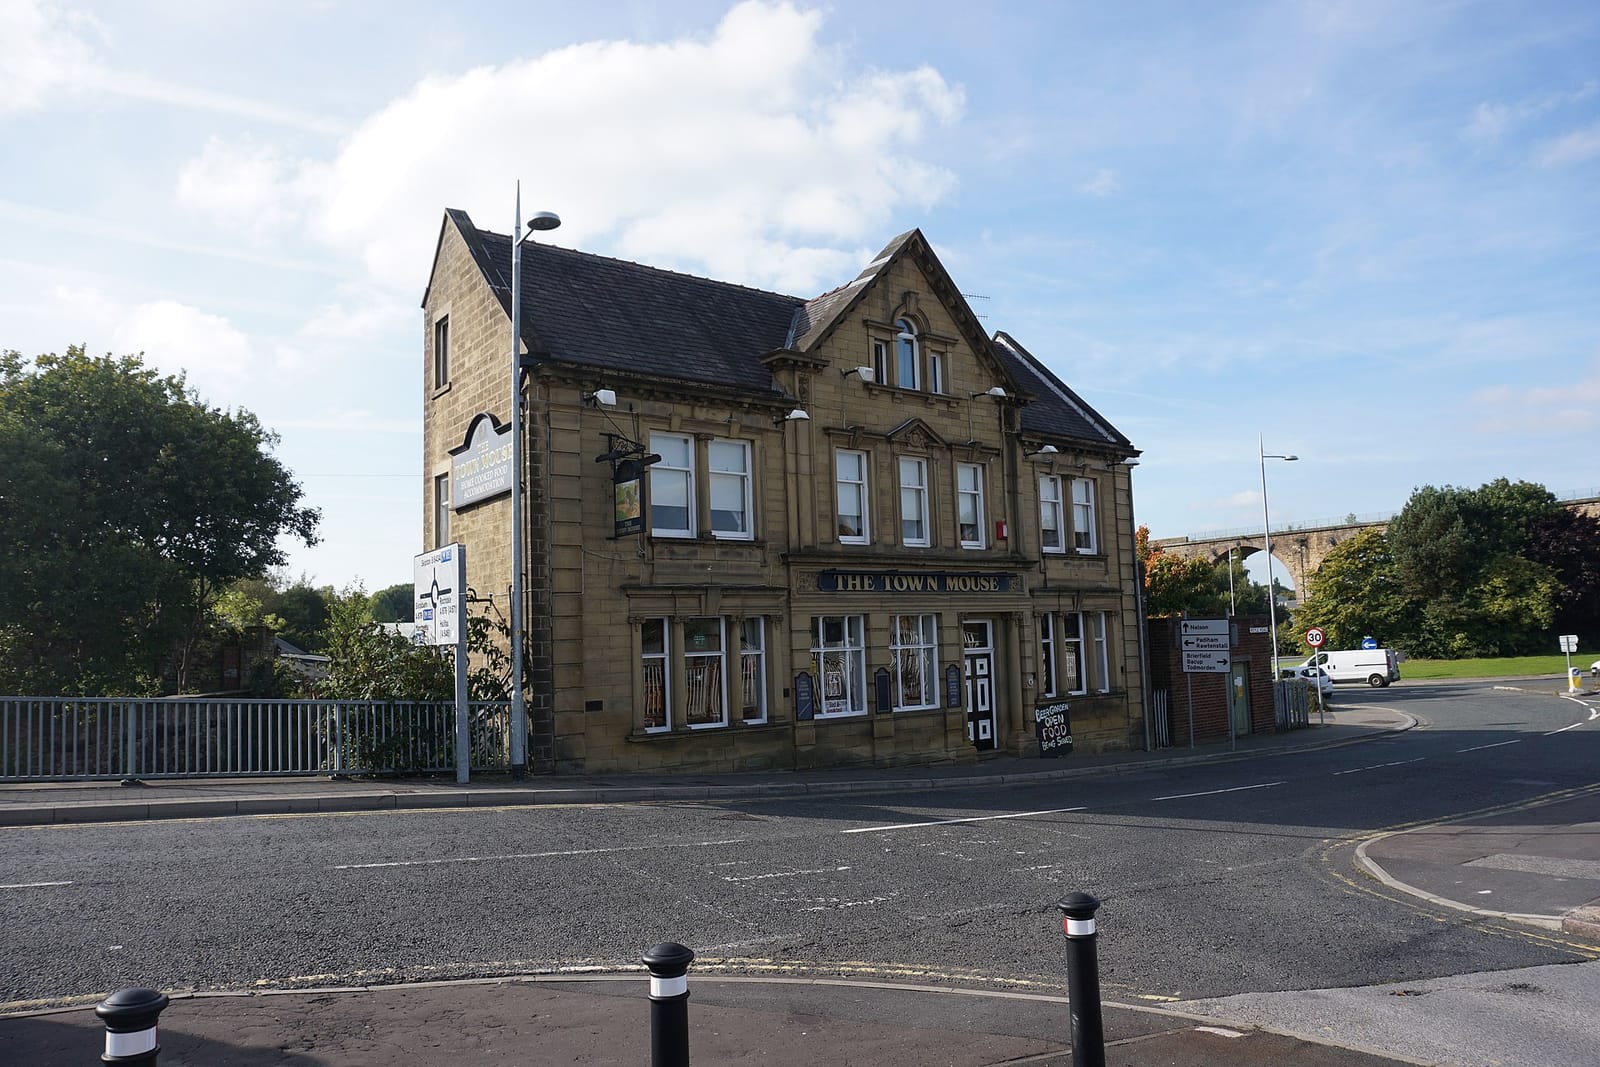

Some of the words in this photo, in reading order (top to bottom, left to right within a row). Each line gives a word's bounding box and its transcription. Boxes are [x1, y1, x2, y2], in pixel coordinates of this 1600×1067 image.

[833, 574, 875, 591] THE
[881, 575, 938, 592] TOWN
[946, 575, 999, 592] MOUSE
[1308, 633, 1321, 642] 30
[1035, 708, 1050, 722] BEER
[1044, 713, 1065, 727] OPEN
[1042, 724, 1067, 740] FOOD
